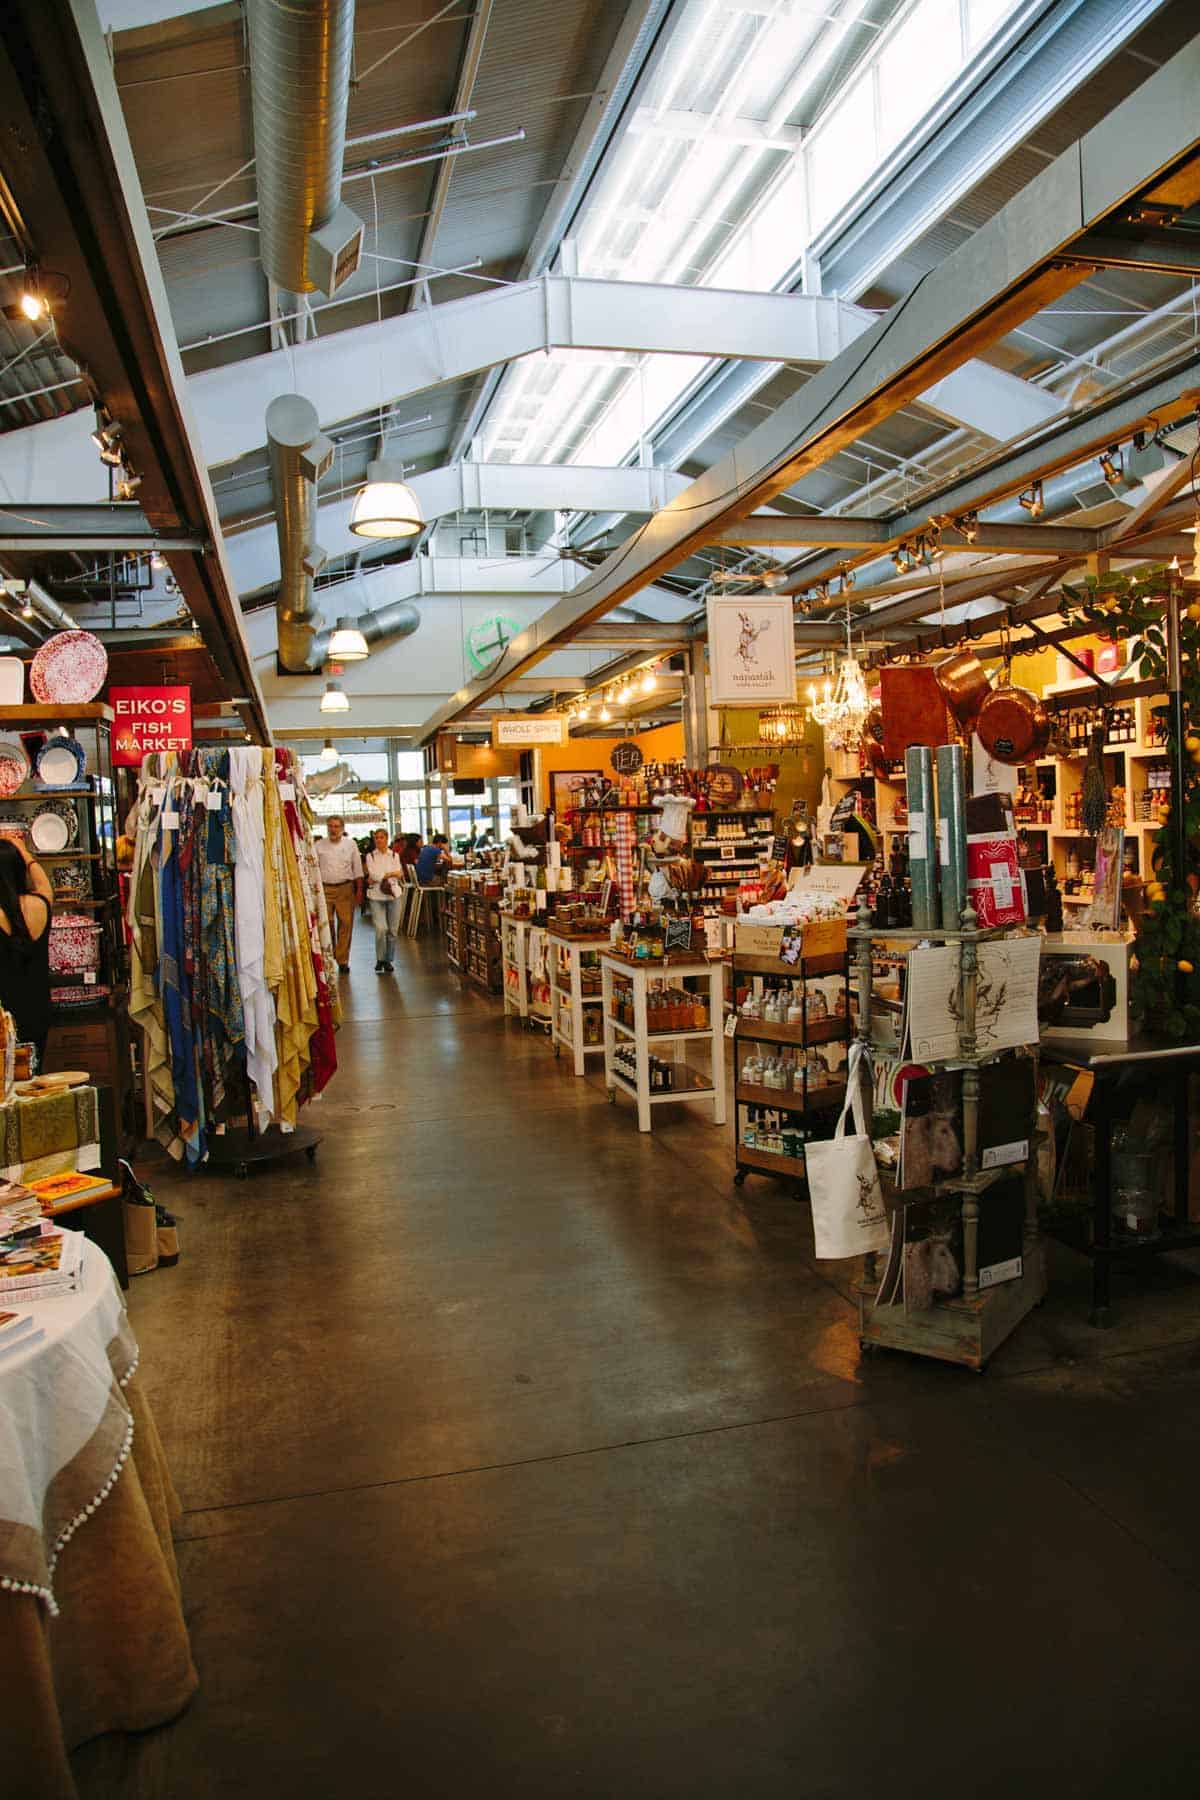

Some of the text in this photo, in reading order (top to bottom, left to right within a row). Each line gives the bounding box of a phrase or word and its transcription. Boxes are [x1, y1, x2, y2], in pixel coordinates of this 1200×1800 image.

[116, 699, 186, 715] EIKO'S
[132, 722, 172, 734] FISH
[116, 738, 189, 751] MARKET
[614, 748, 641, 769] TEA
